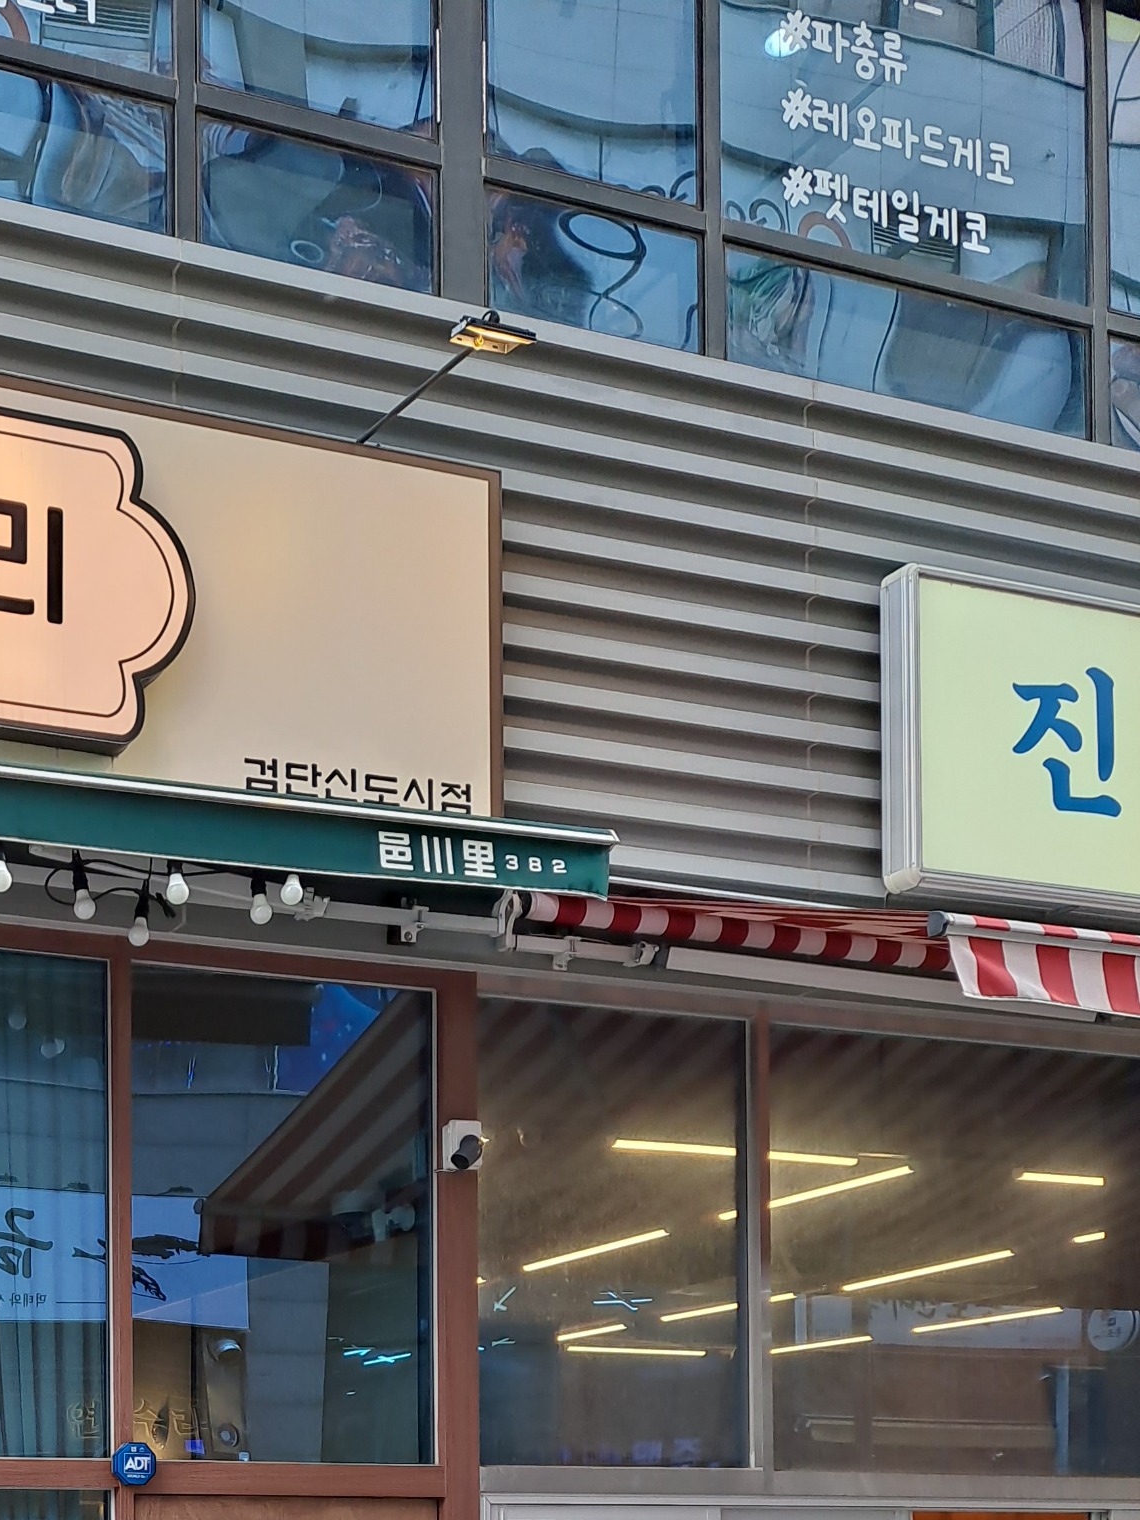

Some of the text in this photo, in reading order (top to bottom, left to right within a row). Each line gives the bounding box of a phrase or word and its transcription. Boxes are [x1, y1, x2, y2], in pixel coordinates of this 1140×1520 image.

[1012, 667, 1122, 817] 진
[244, 757, 472, 815] 검단신도시점
[124, 1457, 150, 1471] ADT
